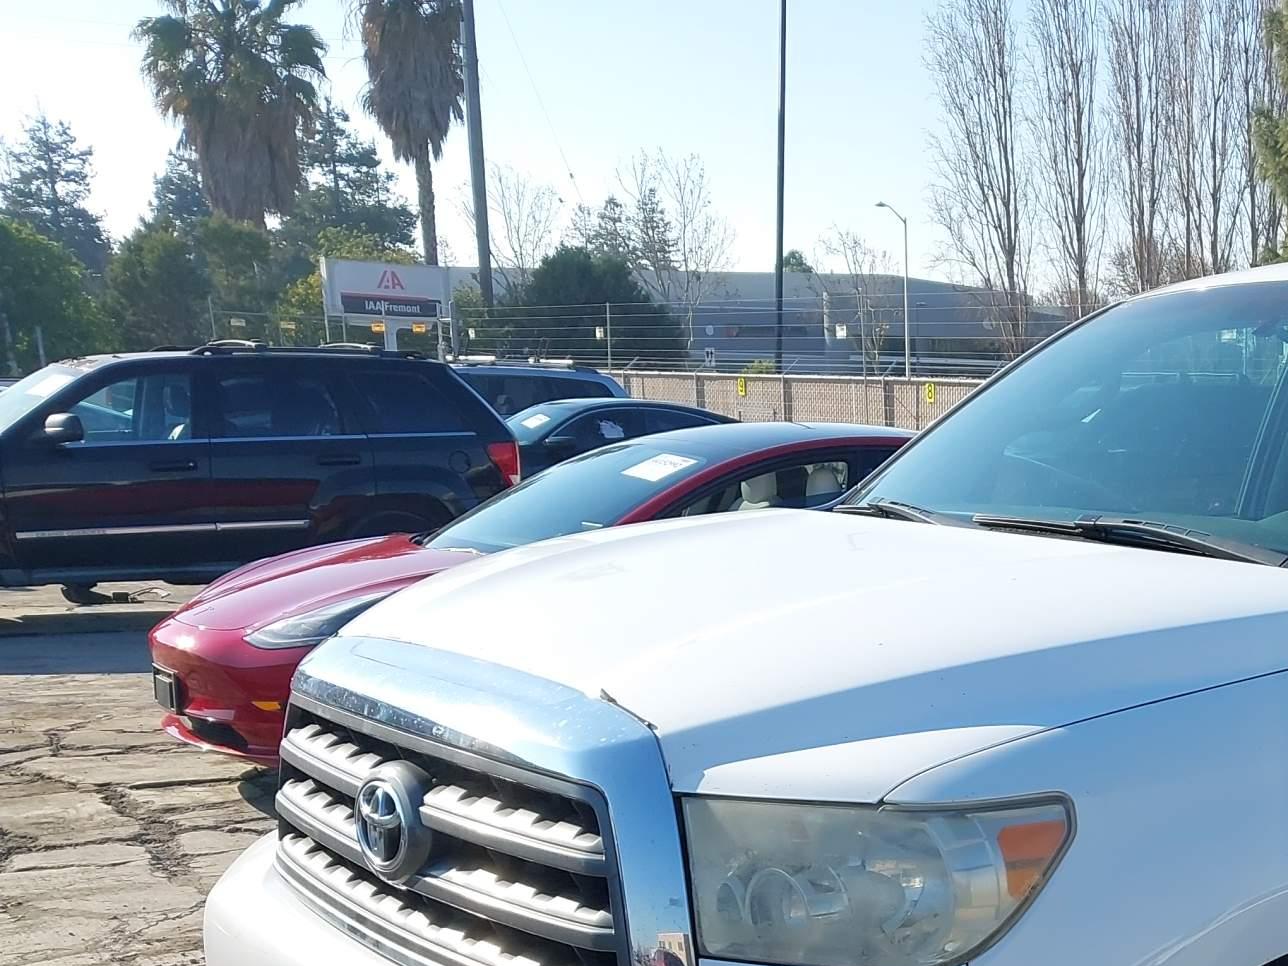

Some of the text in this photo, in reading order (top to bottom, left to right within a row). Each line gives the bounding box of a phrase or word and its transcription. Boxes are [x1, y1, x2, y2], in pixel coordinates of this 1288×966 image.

[365, 300, 421, 313] IAA Fremont
[738, 378, 744, 393] 9
[927, 384, 933, 400] 8
